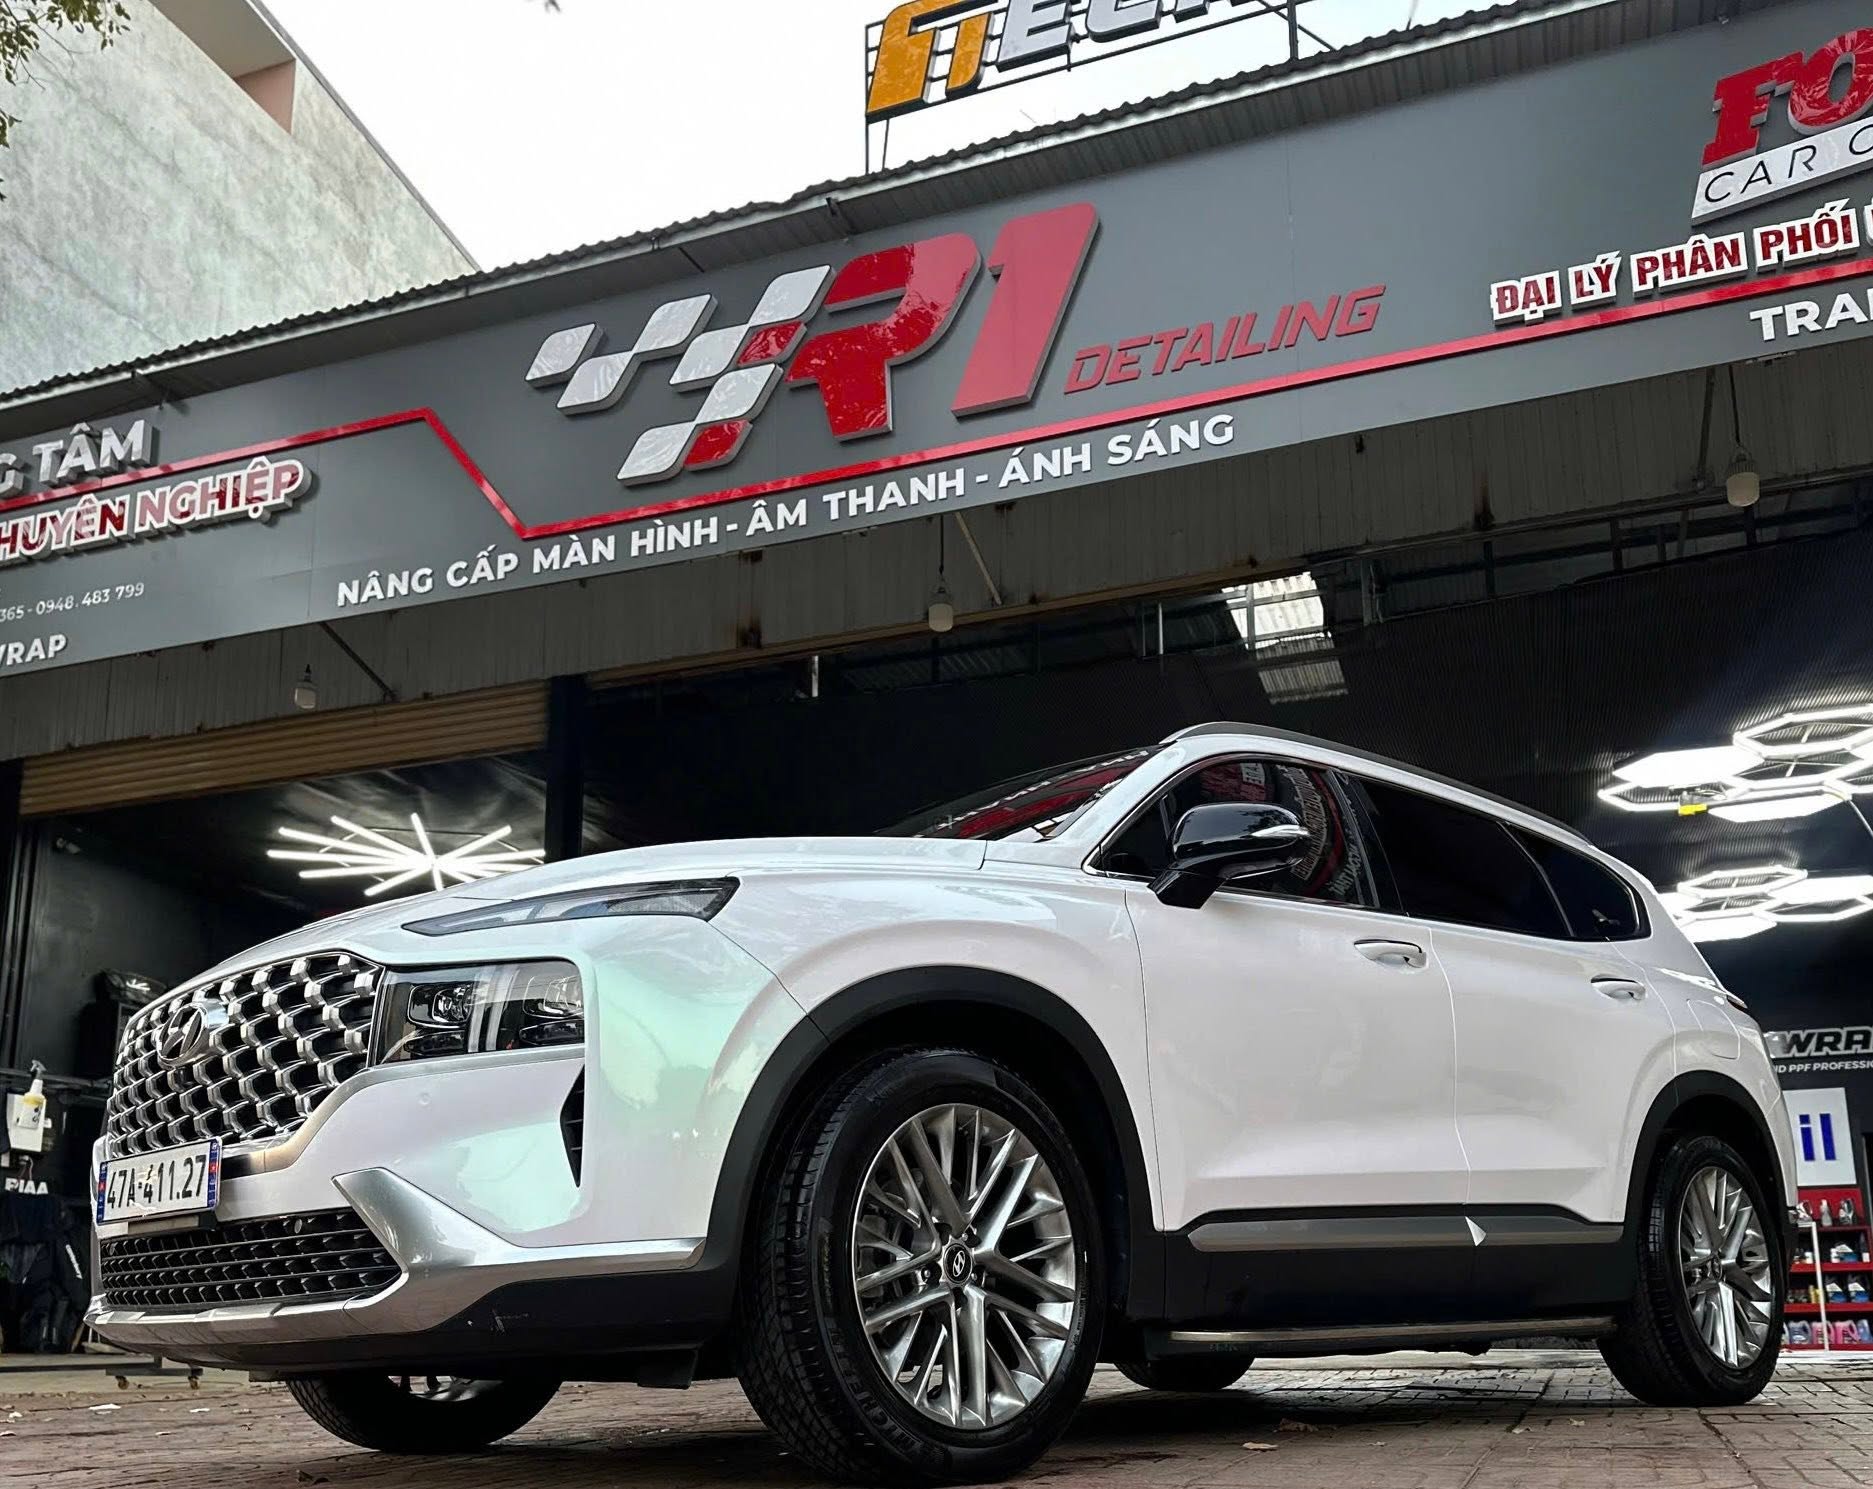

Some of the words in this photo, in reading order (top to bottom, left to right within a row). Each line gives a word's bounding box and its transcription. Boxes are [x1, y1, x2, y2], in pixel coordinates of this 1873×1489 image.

[1704, 144, 1818, 203] CAR
[1493, 273, 1560, 319] ĐẠI
[1570, 253, 1619, 302] LÝ
[1632, 235, 1746, 294] PHÂN
[1755, 200, 1858, 265] PHỐI
[1064, 284, 1386, 394] DETAILING
[1750, 288, 1873, 341] TRA
[32, 419, 149, 484] TÂM
[135, 456, 304, 533] NGHIỆP
[337, 567, 434, 607] NÂNG
[447, 544, 518, 589] CẤP
[533, 534, 615, 574] MÀN
[631, 516, 718, 557] HÌNH
[746, 500, 807, 536] ÂM
[822, 468, 965, 522] THANH
[999, 436, 1091, 488] ÁNH
[1107, 414, 1235, 465] SÁNG
[1788, 1062, 1811, 1073] PPF
[5, 1177, 49, 1195] PIAA
